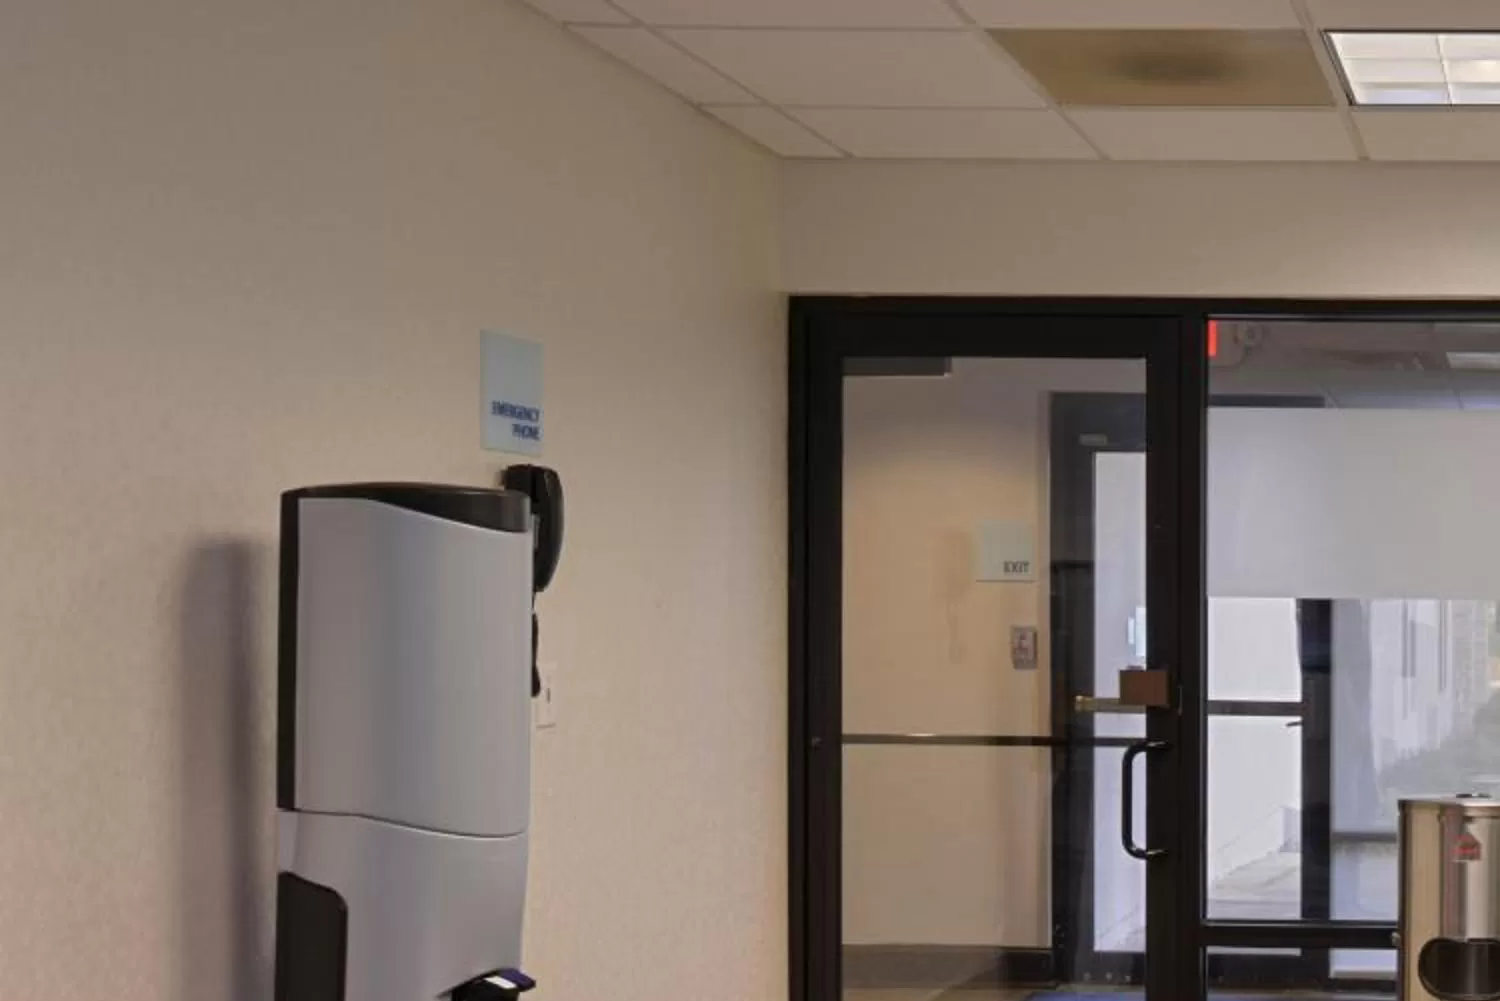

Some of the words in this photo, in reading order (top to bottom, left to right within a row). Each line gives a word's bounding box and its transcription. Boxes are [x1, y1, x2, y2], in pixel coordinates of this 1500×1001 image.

[491, 400, 540, 423] EMERGENCY
[511, 423, 541, 441] PHONE
[1003, 560, 1031, 574] EXIT
